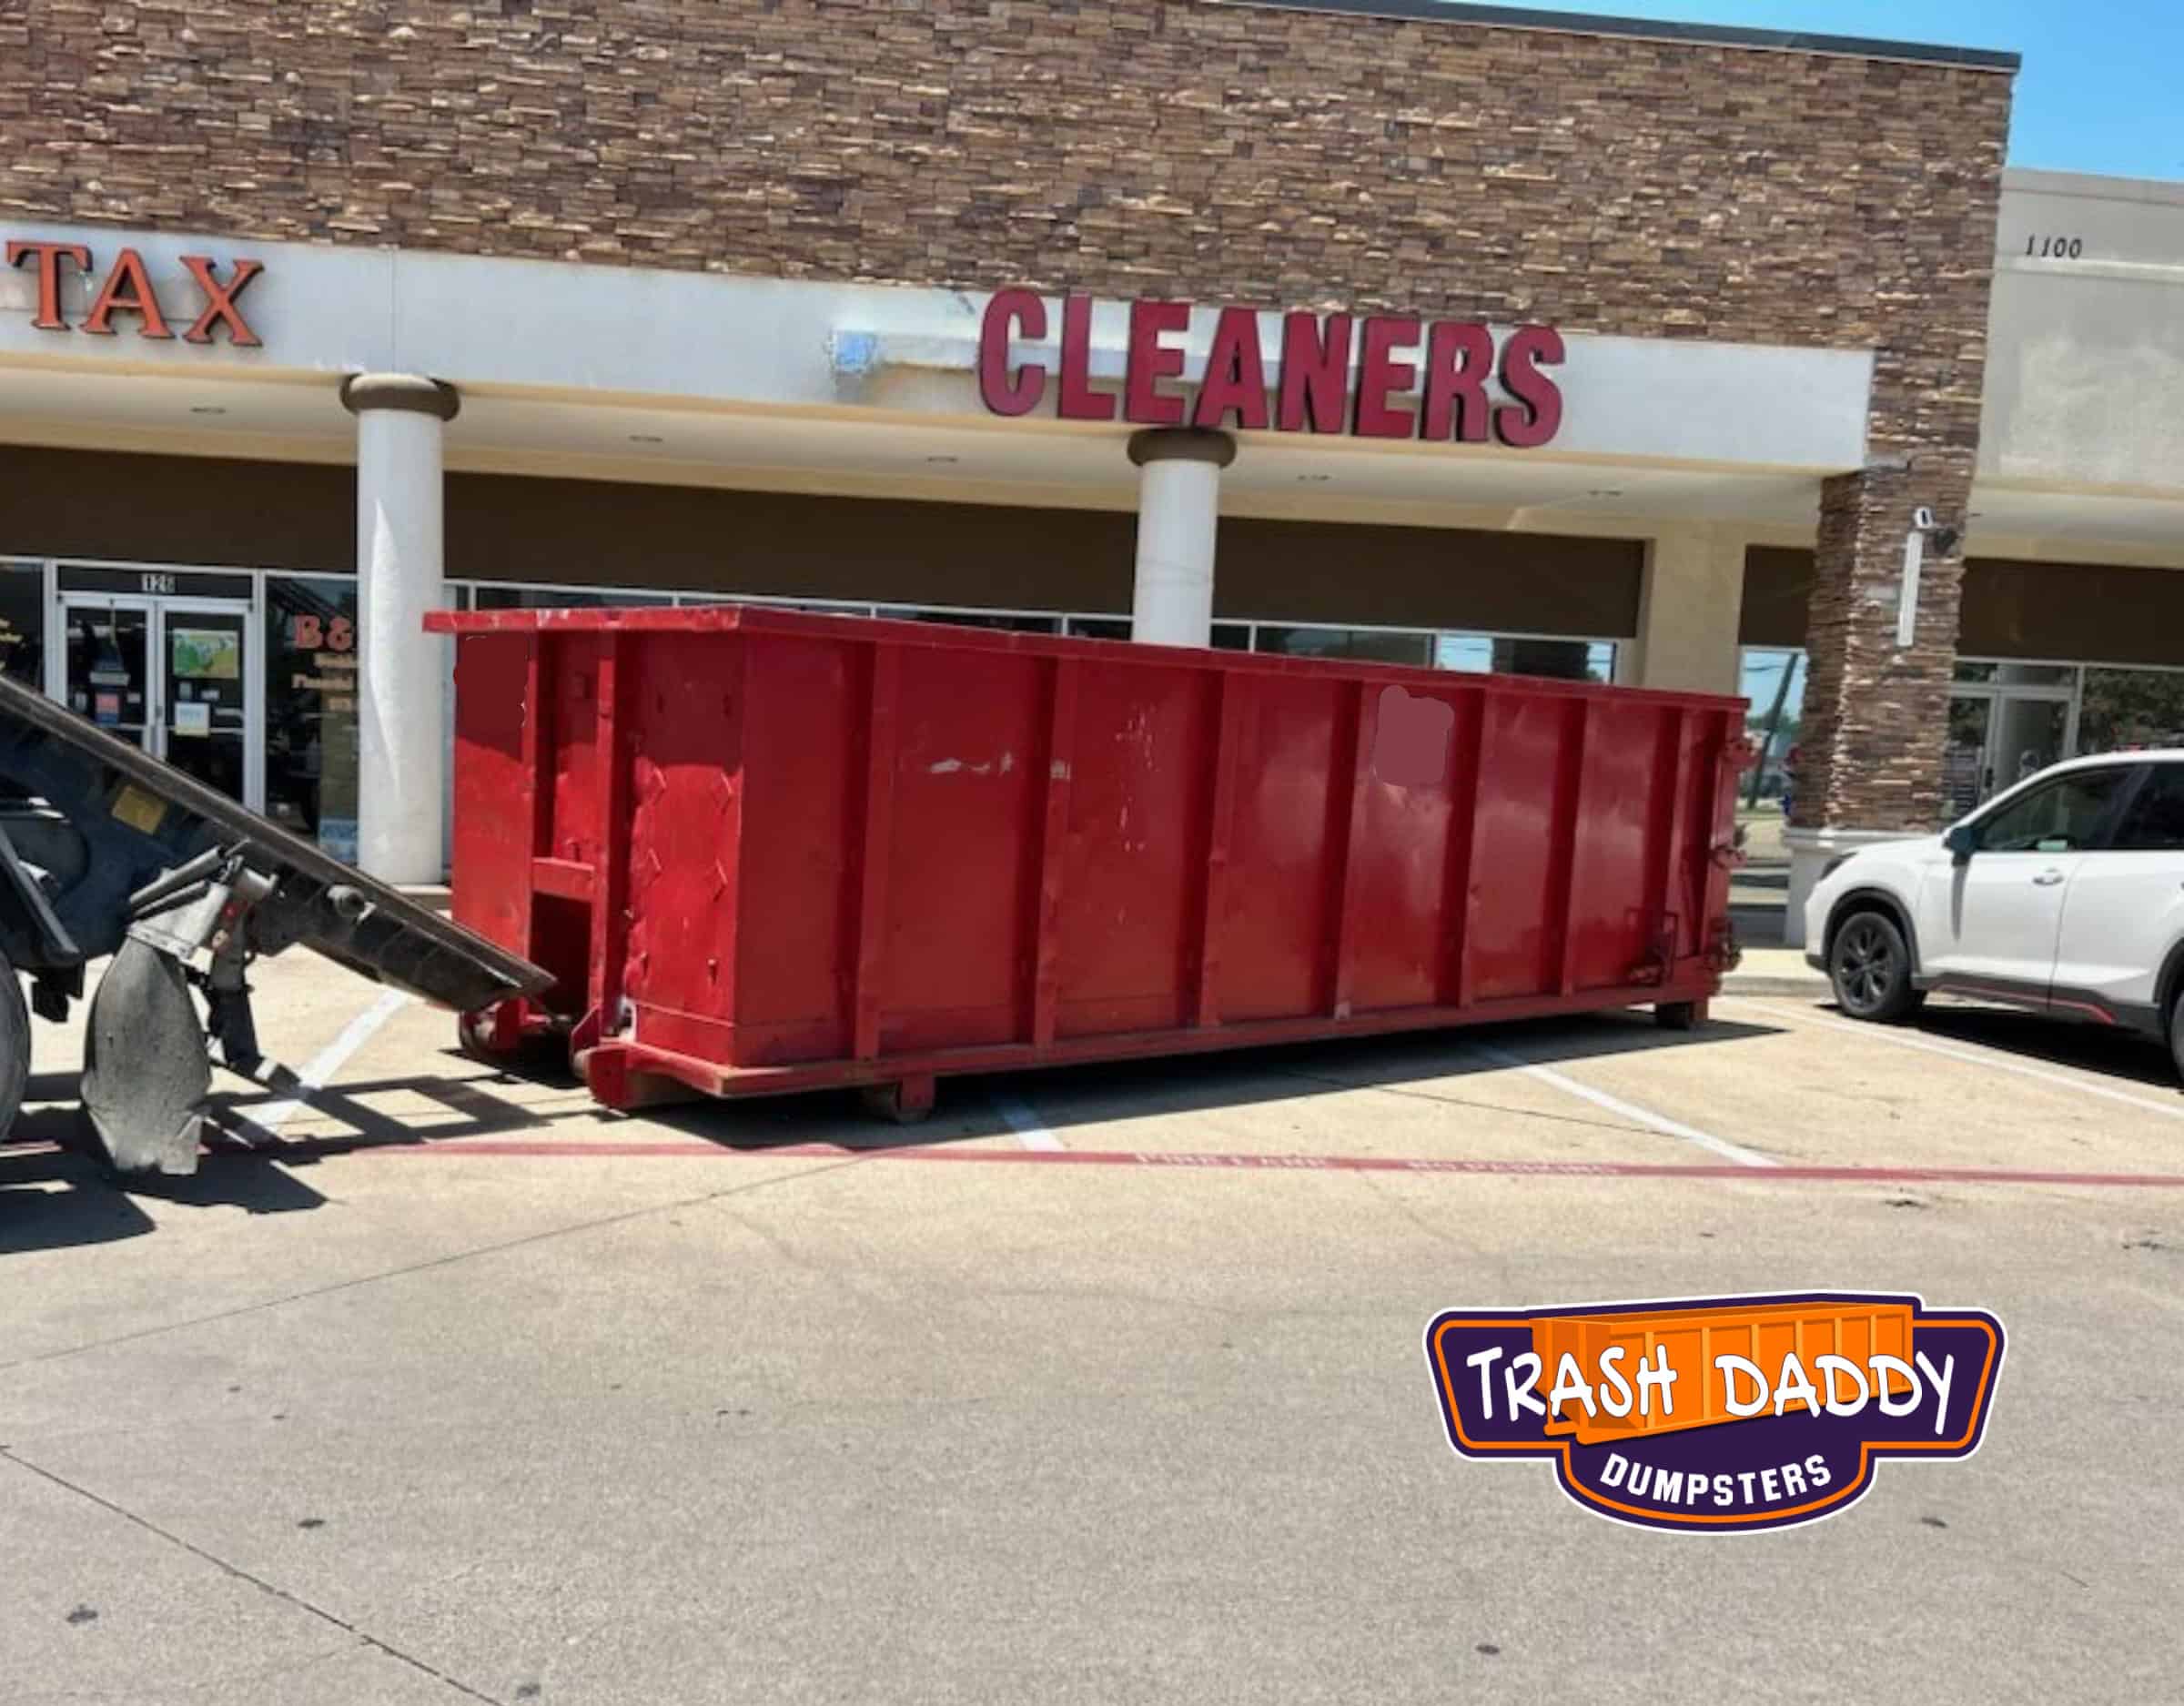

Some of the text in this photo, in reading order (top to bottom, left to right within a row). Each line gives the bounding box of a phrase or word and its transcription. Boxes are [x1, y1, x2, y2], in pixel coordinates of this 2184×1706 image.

[6, 240, 266, 347] TAX
[2025, 234, 2083, 260] 1100
[978, 286, 1566, 448] CLEANERS
